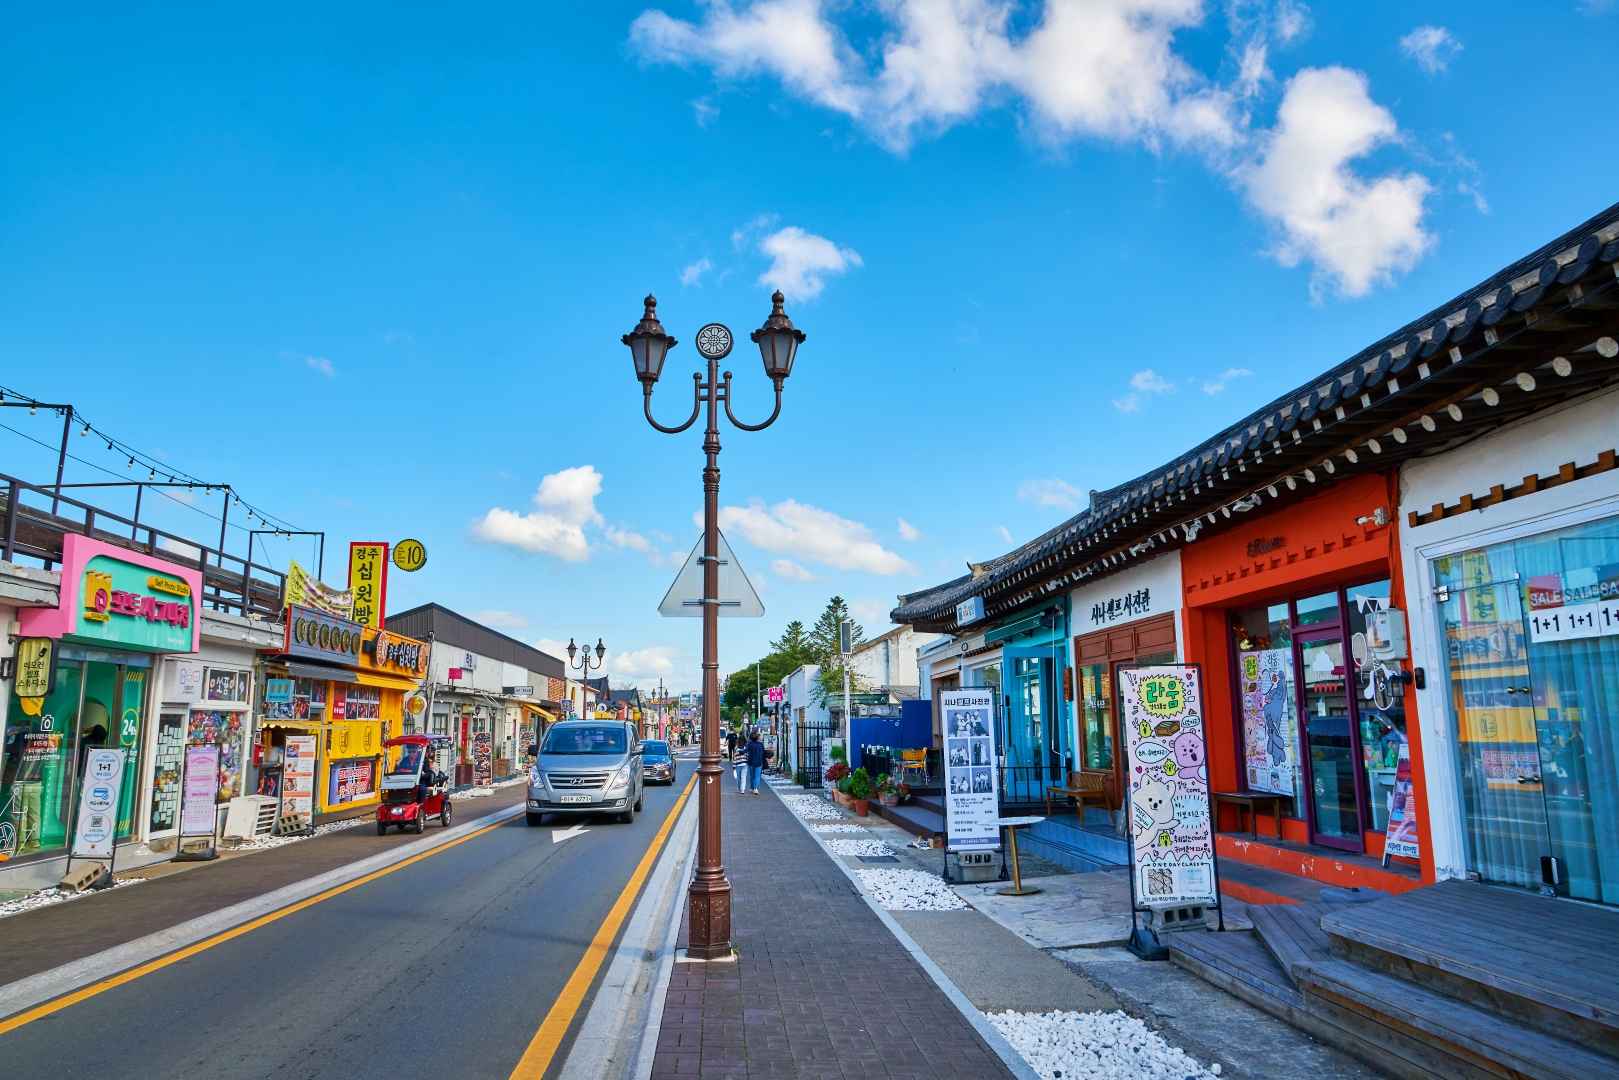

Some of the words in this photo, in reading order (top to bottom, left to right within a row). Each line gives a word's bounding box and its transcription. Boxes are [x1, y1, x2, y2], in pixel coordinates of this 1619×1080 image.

[357, 548, 379, 560] 경주
[407, 546, 421, 565] 10
[355, 561, 373, 625] 십원빵
[1530, 592, 1562, 606] SALE
[1564, 583, 1600, 601] SALE
[1532, 614, 1560, 634] 1+1
[1569, 611, 1593, 629] 1+1
[16, 679, 47, 689] 스튜디오
[1146, 680, 1180, 709] 라움
[98, 763, 111, 772] 1+1
